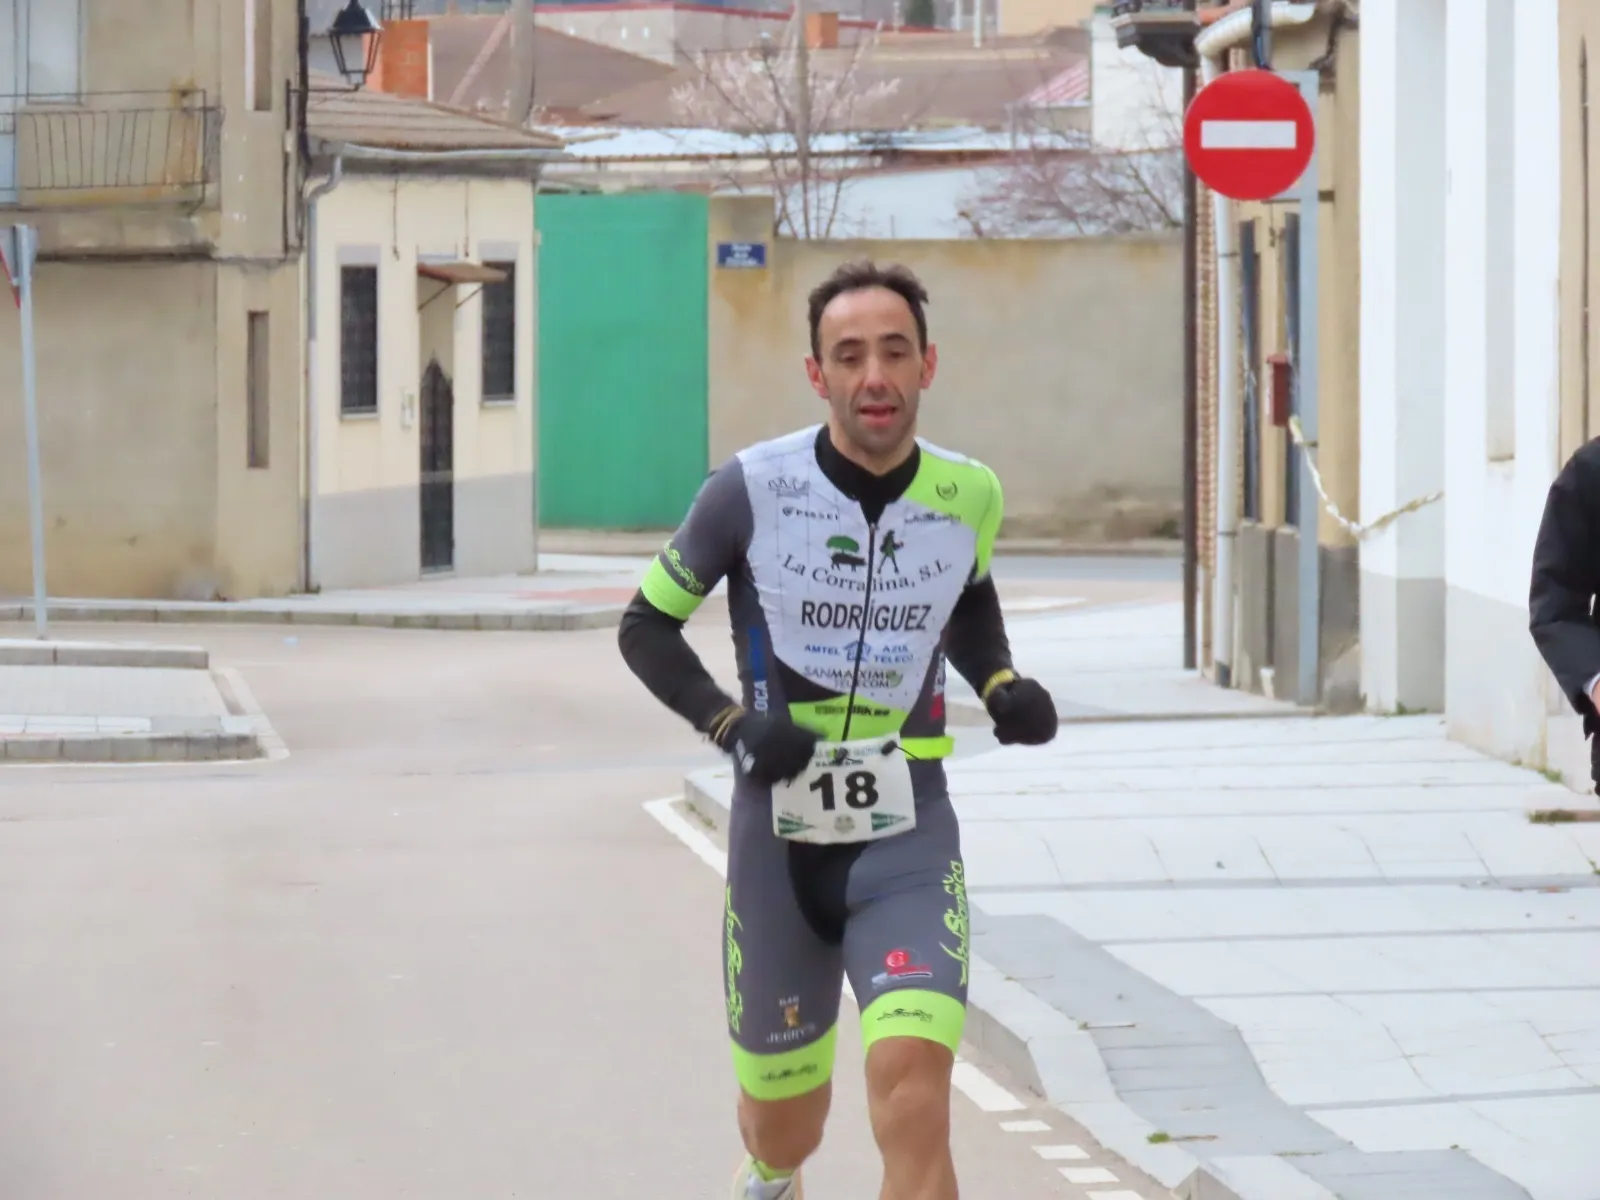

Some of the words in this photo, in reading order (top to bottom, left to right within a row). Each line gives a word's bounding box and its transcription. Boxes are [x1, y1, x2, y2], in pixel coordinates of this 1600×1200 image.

[782, 554, 806, 576] La
[918, 558, 952, 582] S.L.
[801, 600, 932, 631] RODRÍGUEZ
[804, 643, 840, 656] AMTEL
[809, 771, 879, 811] 18
